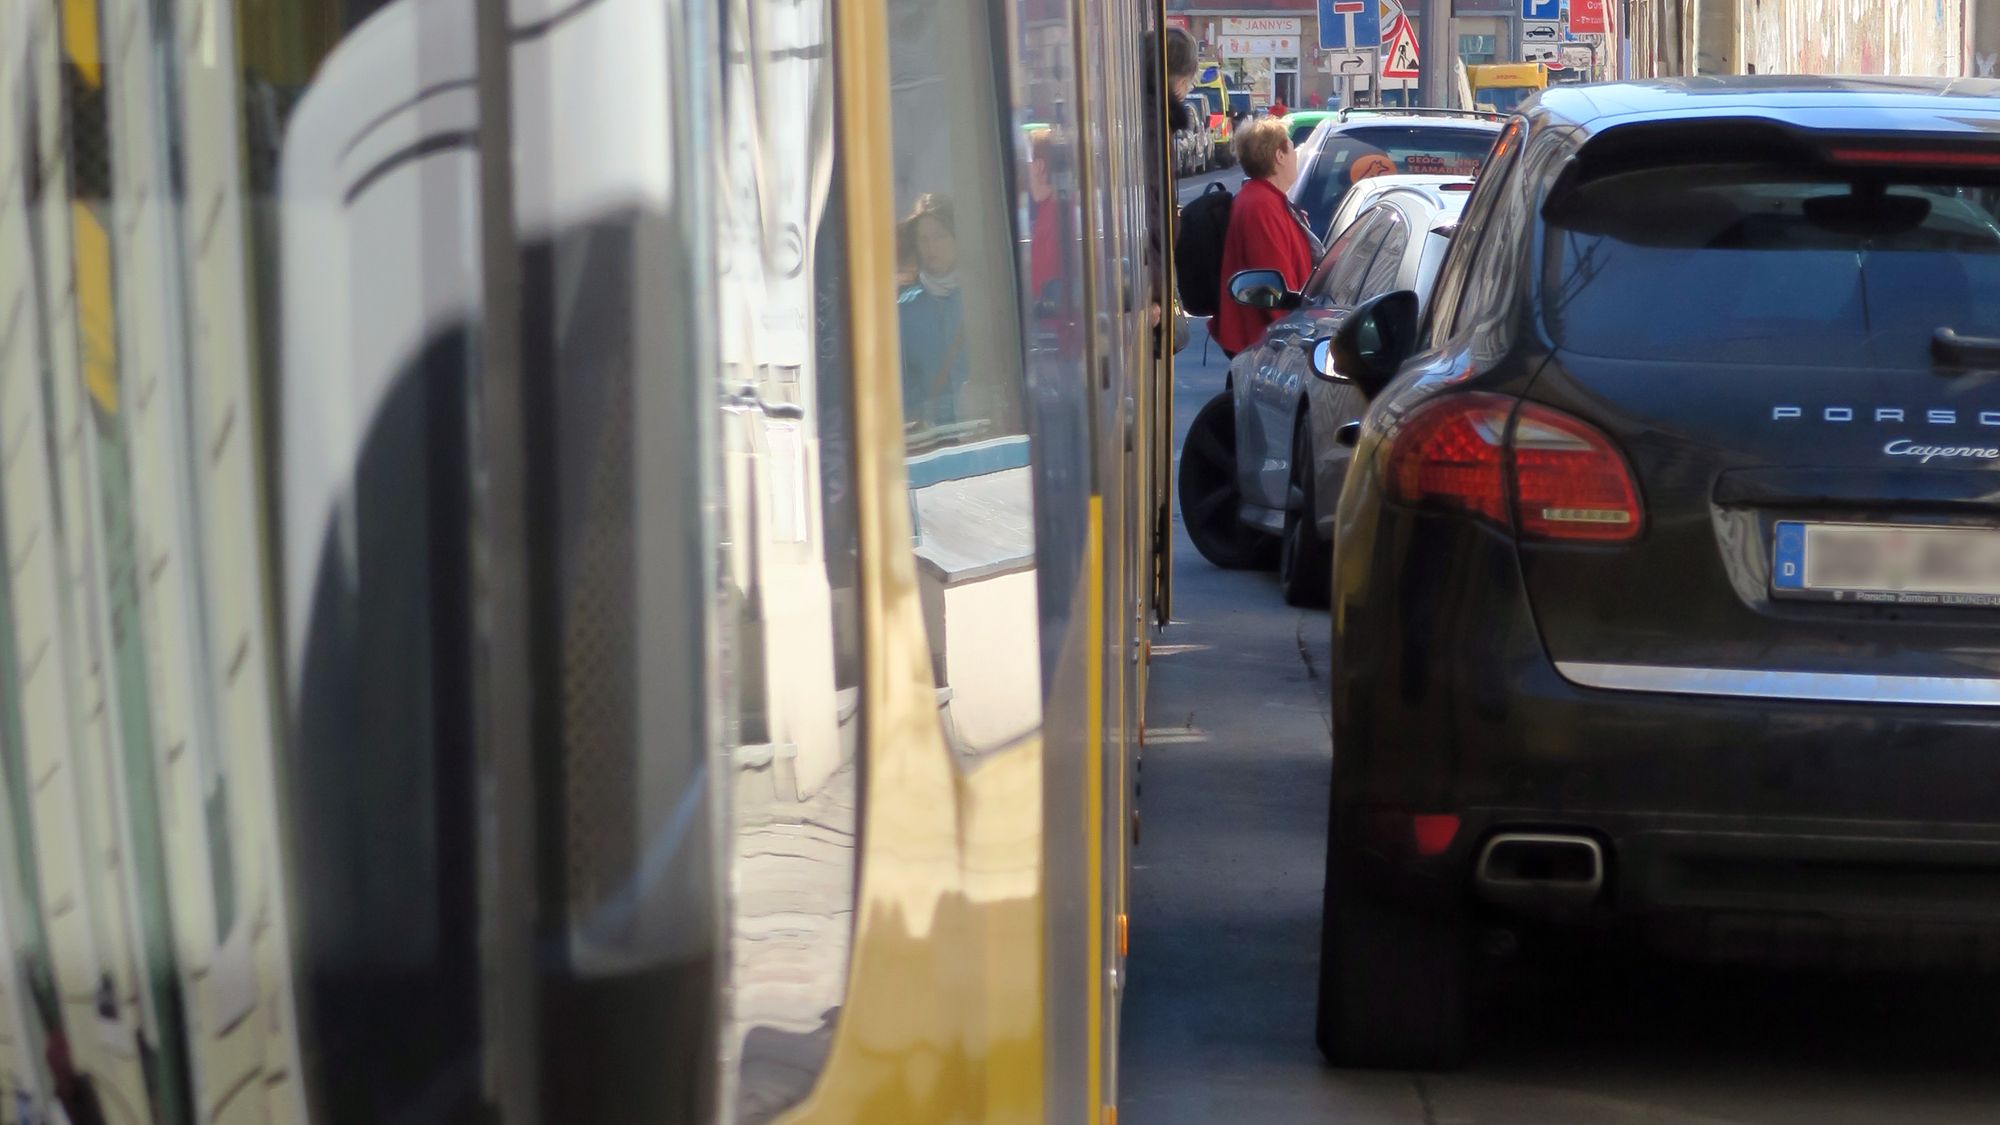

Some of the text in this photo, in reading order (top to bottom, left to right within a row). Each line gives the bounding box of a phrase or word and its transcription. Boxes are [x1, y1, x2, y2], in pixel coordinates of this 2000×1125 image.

[1246, 20, 1293, 30] JANNY'S
[1883, 439, 2000, 464] Cayenne
[1783, 562, 1796, 577] D
[1855, 591, 1896, 602] Porsche
[1898, 593, 1938, 604] Zentrum
